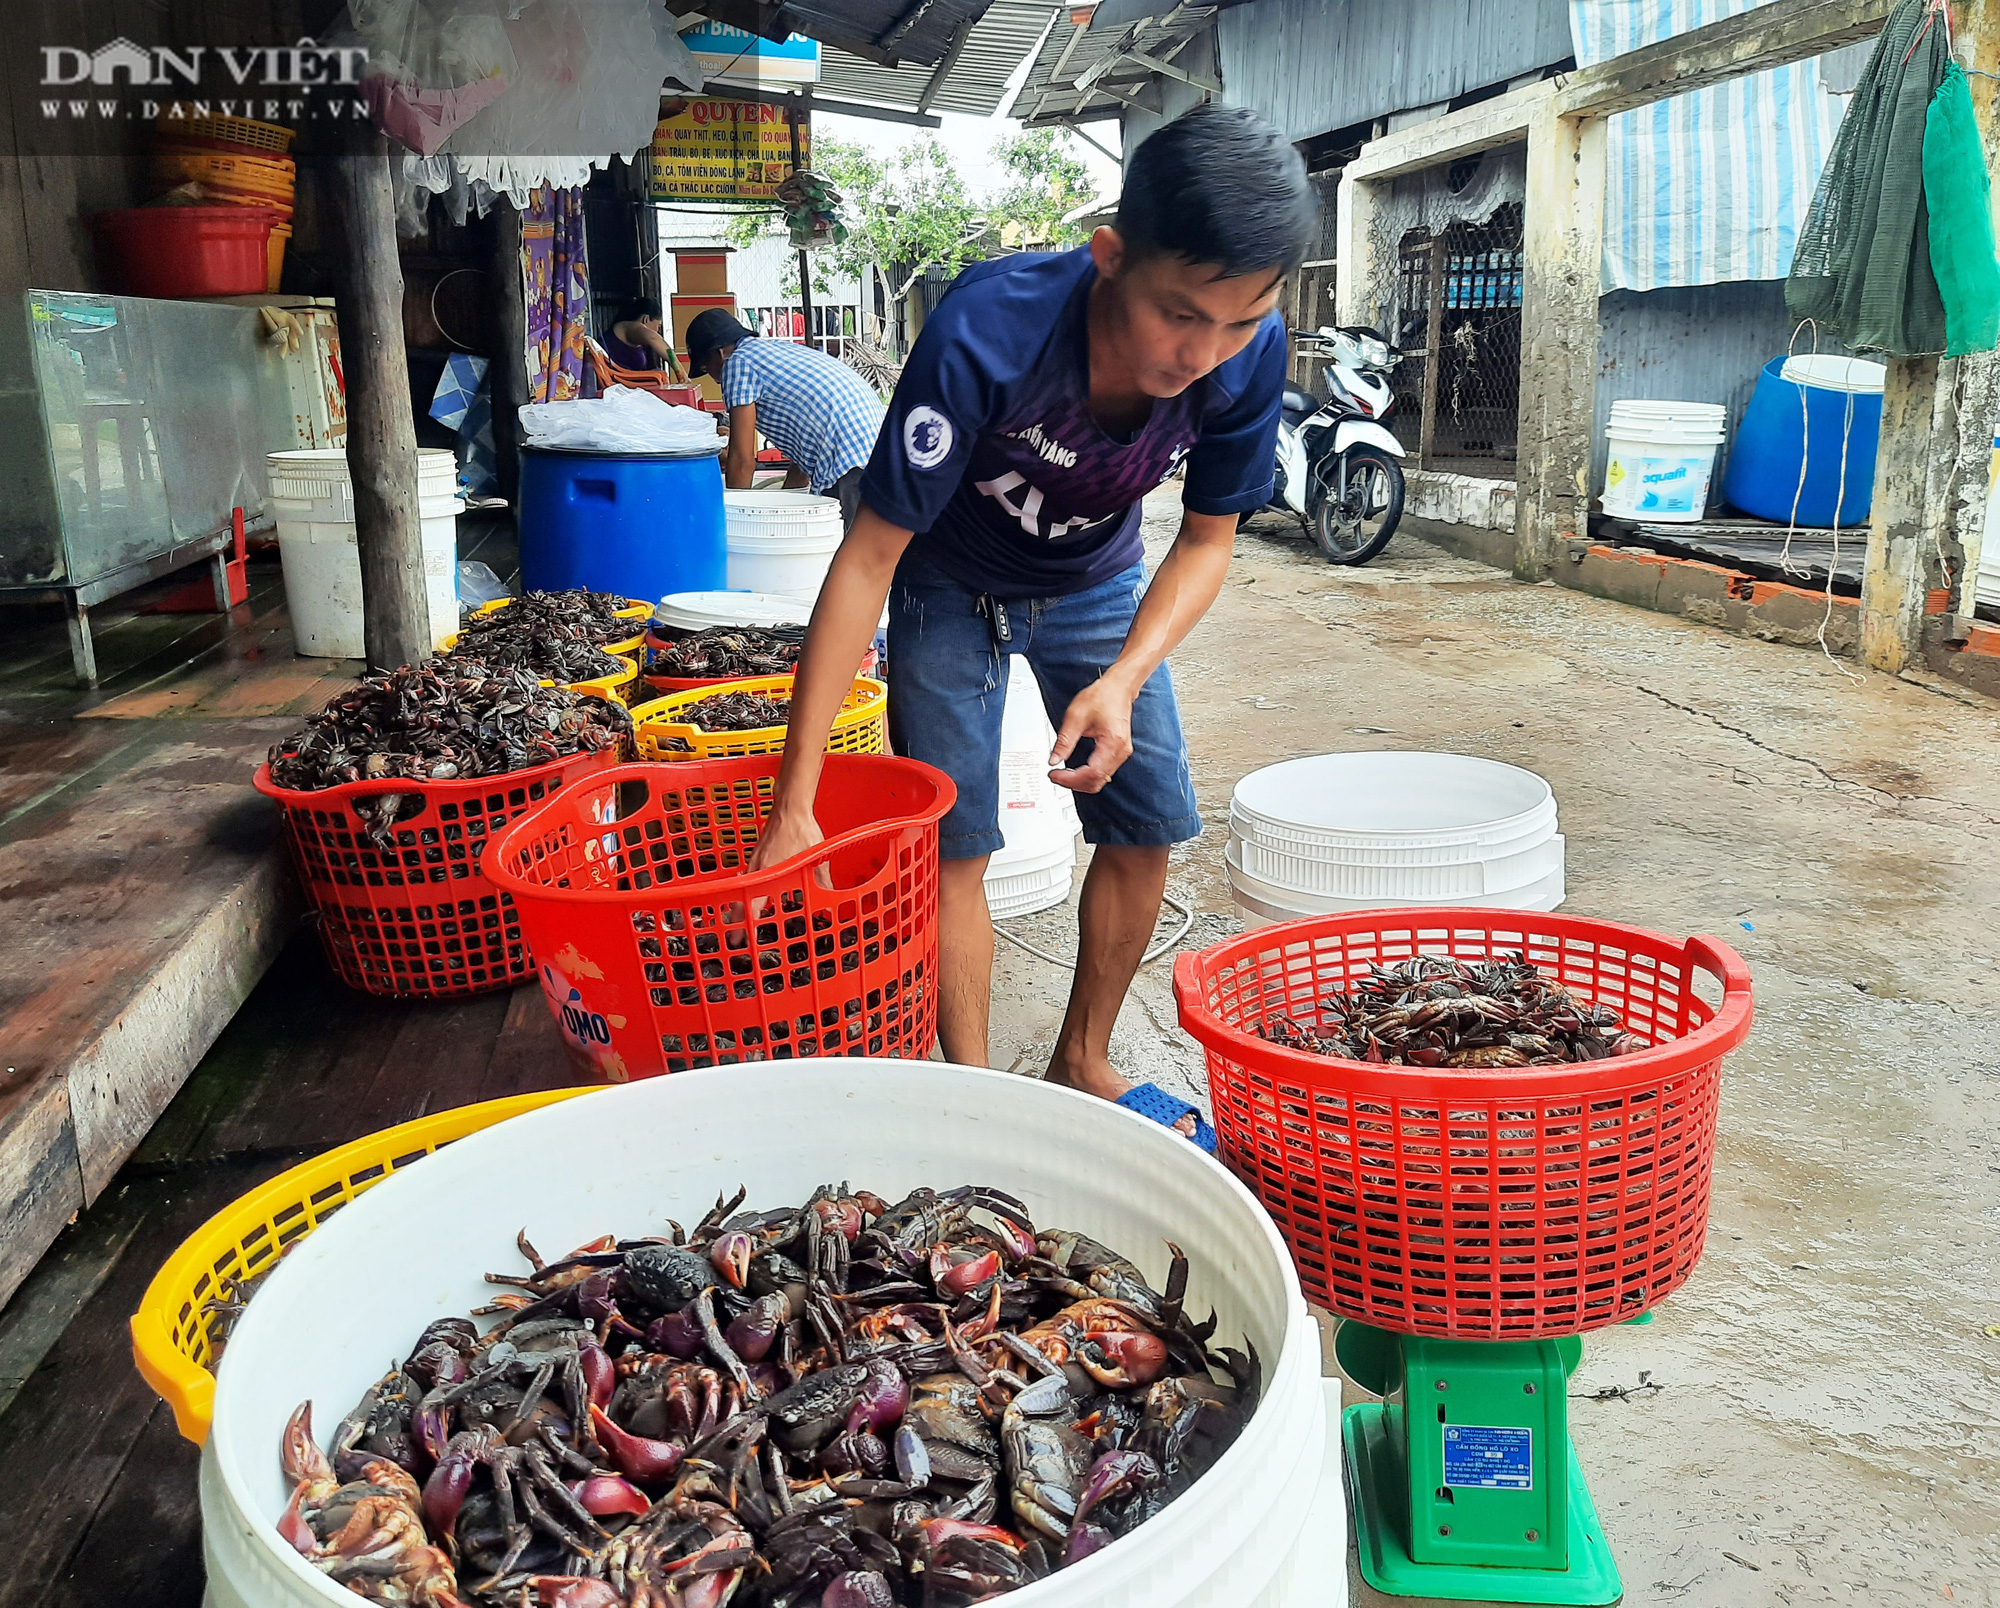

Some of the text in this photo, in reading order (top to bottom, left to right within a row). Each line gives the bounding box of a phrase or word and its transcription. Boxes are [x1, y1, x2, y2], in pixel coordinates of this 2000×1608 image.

[675, 129, 691, 140] QUAY
[713, 130, 728, 142] HEO,
[670, 145, 687, 158] TRÂU,
[689, 145, 701, 160] BÒ,
[715, 145, 728, 159] XÚC
[665, 162, 677, 177] CÁ,
[677, 163, 692, 176] TÔM
[693, 163, 708, 177] VIÊN
[668, 180, 679, 192] CÁ
[562, 1004, 611, 1045] OMO
